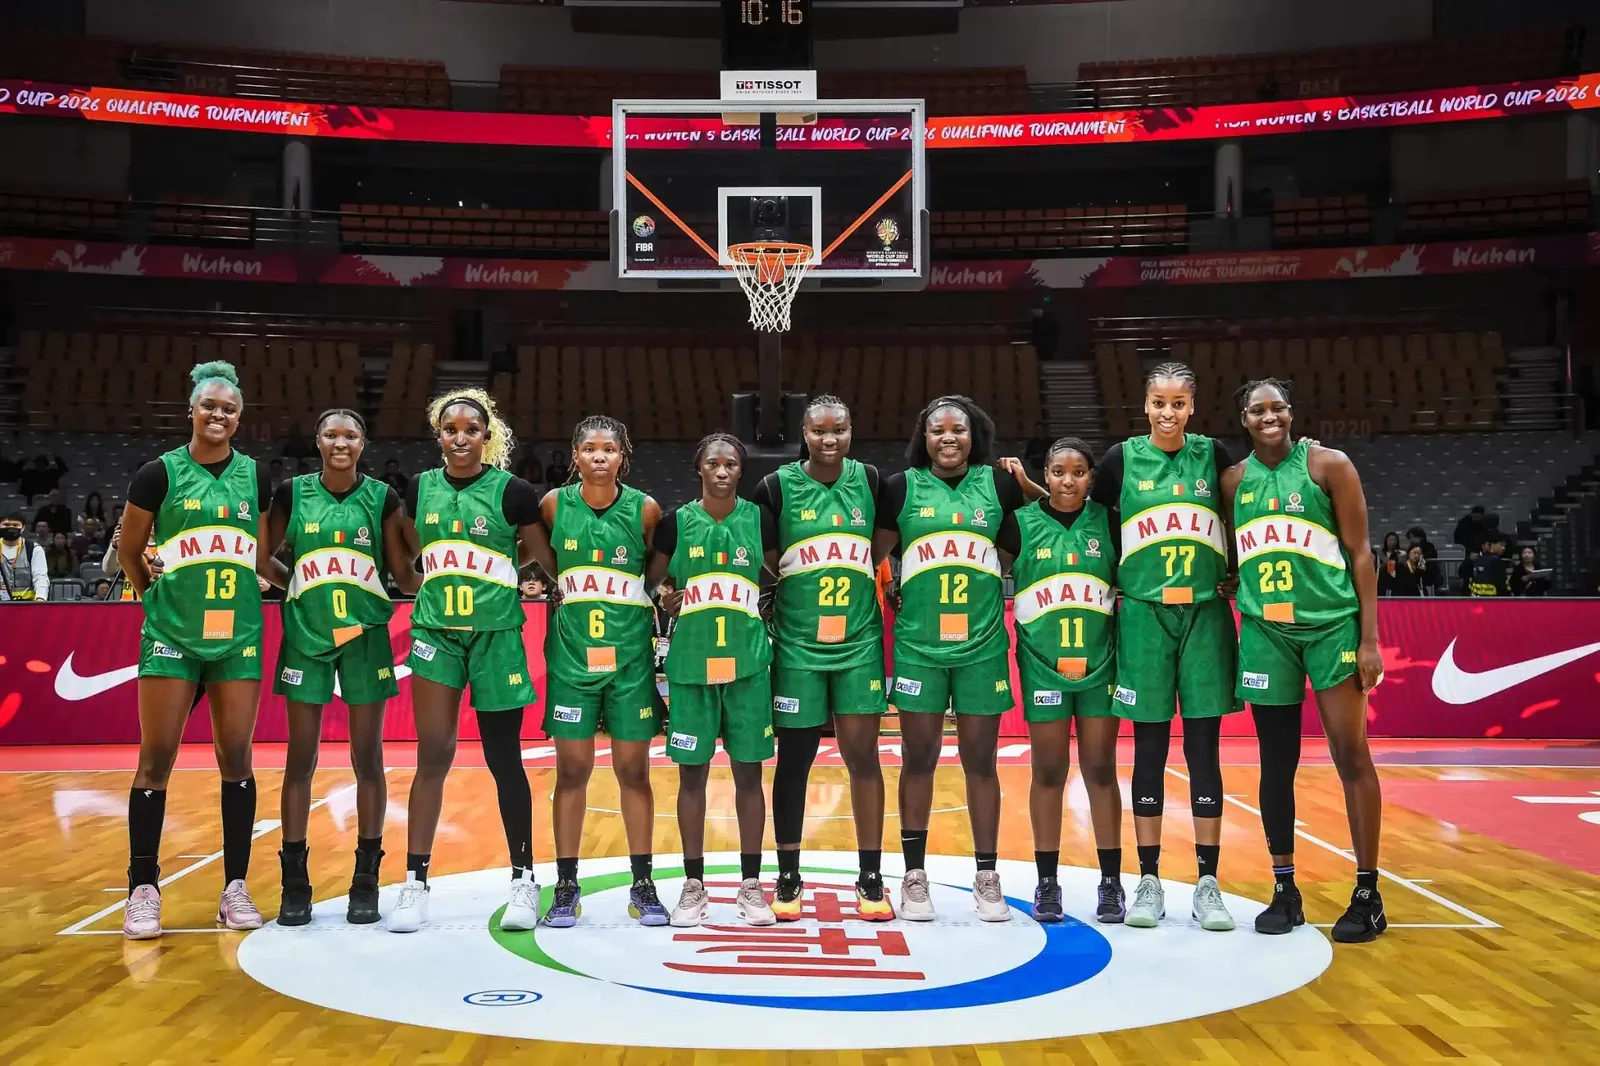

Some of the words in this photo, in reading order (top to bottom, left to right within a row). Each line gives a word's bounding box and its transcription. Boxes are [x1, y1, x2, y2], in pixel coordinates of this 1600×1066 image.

[754, 80, 802, 90] TISSOT
[16, 89, 55, 107] CUP
[58, 93, 101, 111] 2026
[106, 97, 200, 119] QUALIFYING
[205, 105, 311, 126] TOURNAMENT
[1338, 99, 1434, 121] BASKETBALL
[1440, 93, 1498, 113] WORLD
[1503, 89, 1542, 107] CUP
[1545, 85, 1588, 103] 2026
[811, 127, 861, 141] WORLD
[866, 127, 898, 141] CUP
[941, 123, 1024, 140] QUALIFYING
[1028, 119, 1127, 137] TOURNAMENT
[635, 242, 654, 252] FIBA
[1452, 247, 1536, 267] Wuhan
[182, 252, 262, 275] Wuhan
[464, 263, 539, 284] Wuhan
[1140, 266, 1211, 281] QUALIFYING
[1216, 262, 1300, 278] TOURNAMENT
[930, 266, 1004, 285] Wuhan
[184, 498, 201, 510] WA
[801, 509, 817, 521] WA
[920, 507, 935, 518] WA
[1137, 512, 1214, 539] MALI
[1240, 524, 1312, 552] MALI
[425, 549, 494, 574] MALI
[689, 546, 705, 558] WA
[800, 542, 870, 566] MALI
[1036, 548, 1052, 560] WA
[1160, 545, 1196, 577] 77
[302, 557, 375, 582] MALI
[1258, 560, 1294, 594] 23
[205, 568, 237, 600] 13
[684, 582, 750, 606] MALI
[818, 576, 851, 607] 22
[939, 573, 969, 604] 12
[332, 589, 347, 619] 0
[444, 585, 474, 616] 10
[589, 609, 605, 639] 6
[715, 616, 726, 647] 1
[1059, 617, 1084, 648] 11
[941, 632, 966, 640] orange
[589, 664, 614, 672] orange
[1034, 694, 1060, 704] 1XBET
[555, 710, 580, 721] 1XBET
[671, 736, 695, 749] 1XBET
